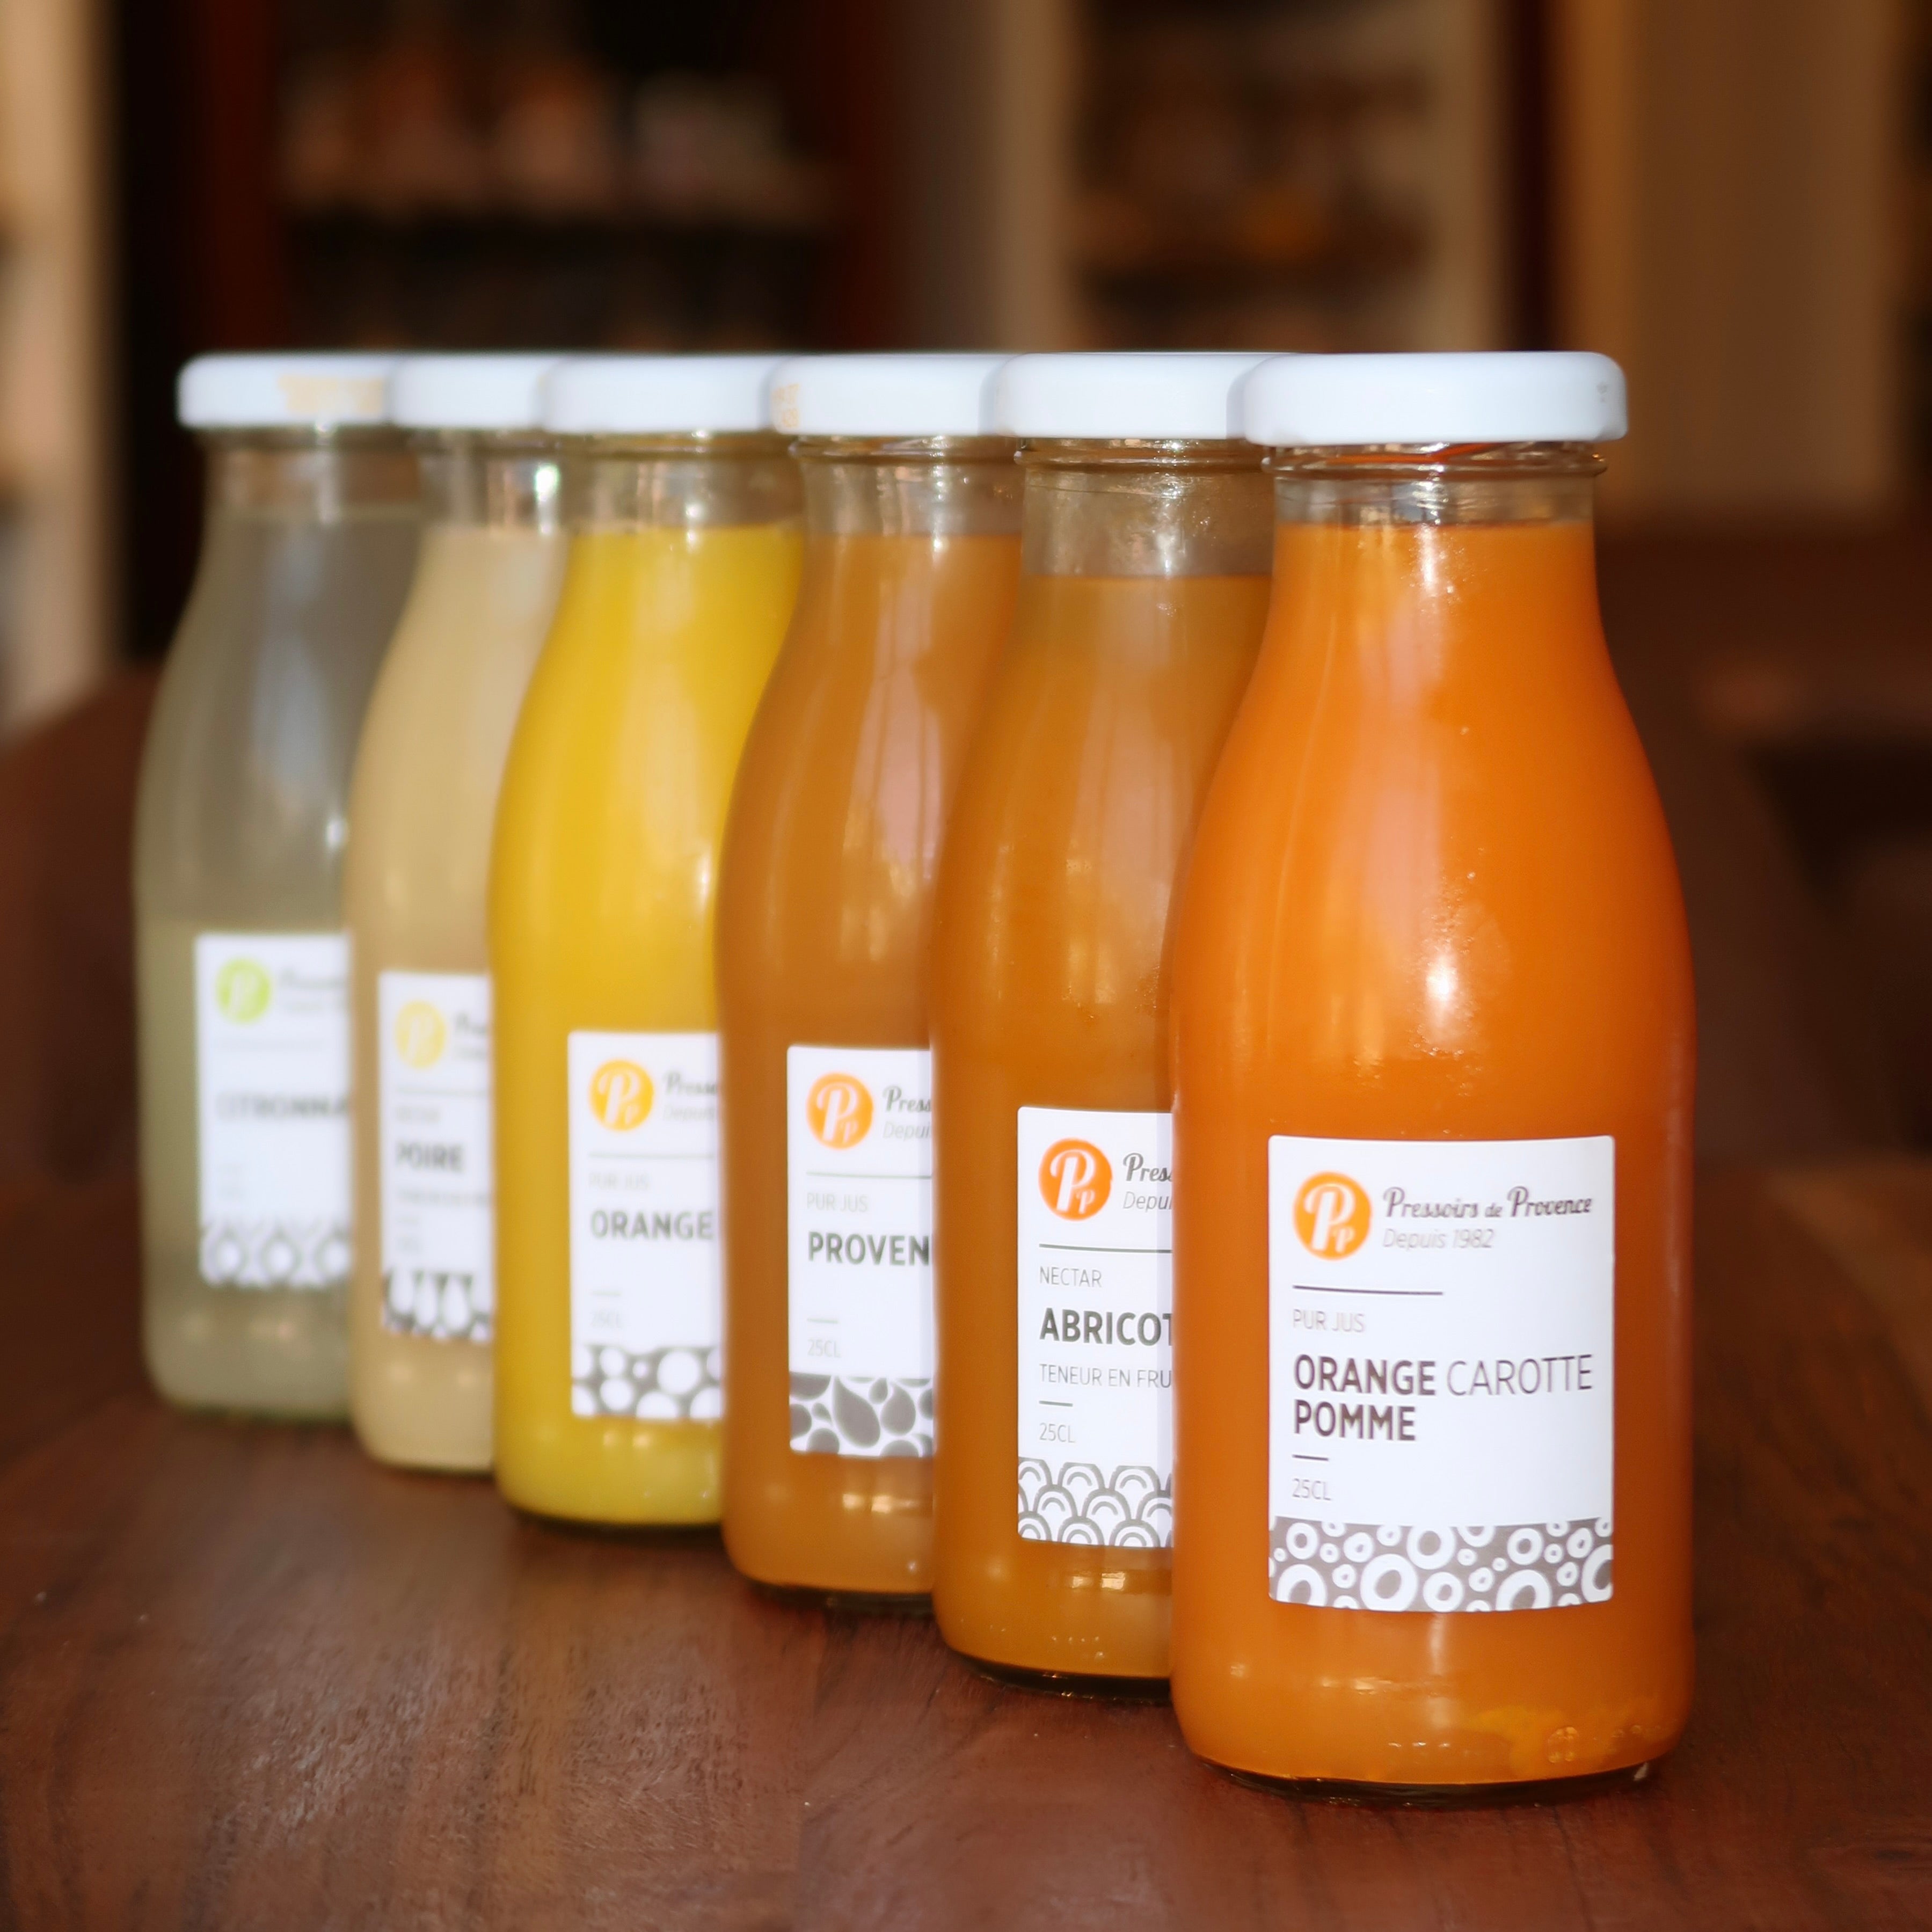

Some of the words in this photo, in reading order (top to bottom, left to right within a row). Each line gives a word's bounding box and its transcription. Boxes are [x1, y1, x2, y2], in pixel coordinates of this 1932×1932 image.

[395, 1139, 465, 1173] POIRE
[807, 1192, 837, 1211] PUR
[840, 1194, 868, 1213] JUS
[1382, 1186, 1479, 1218] Pressoirs
[1484, 1202, 1504, 1218] de
[1507, 1185, 1595, 1217] Provence
[590, 1209, 714, 1242] ORANGE
[808, 1231, 930, 1267] PROVEN
[1383, 1228, 1447, 1251] Depuis
[1453, 1228, 1496, 1249] 1982
[1039, 1265, 1102, 1288] NECTAR
[1293, 1308, 1326, 1331] PUR
[1332, 1312, 1365, 1333] JUS
[807, 1338, 841, 1359] 25CL
[1039, 1363, 1103, 1387] TENEUR
[1108, 1368, 1131, 1387] EN
[1137, 1369, 1172, 1389] FRU
[1293, 1353, 1437, 1396] ORANGE
[1447, 1353, 1593, 1396] CAROTTE
[1293, 1398, 1417, 1442] POMME
[1039, 1422, 1076, 1444] 25CL
[1292, 1478, 1332, 1501] 25CL
